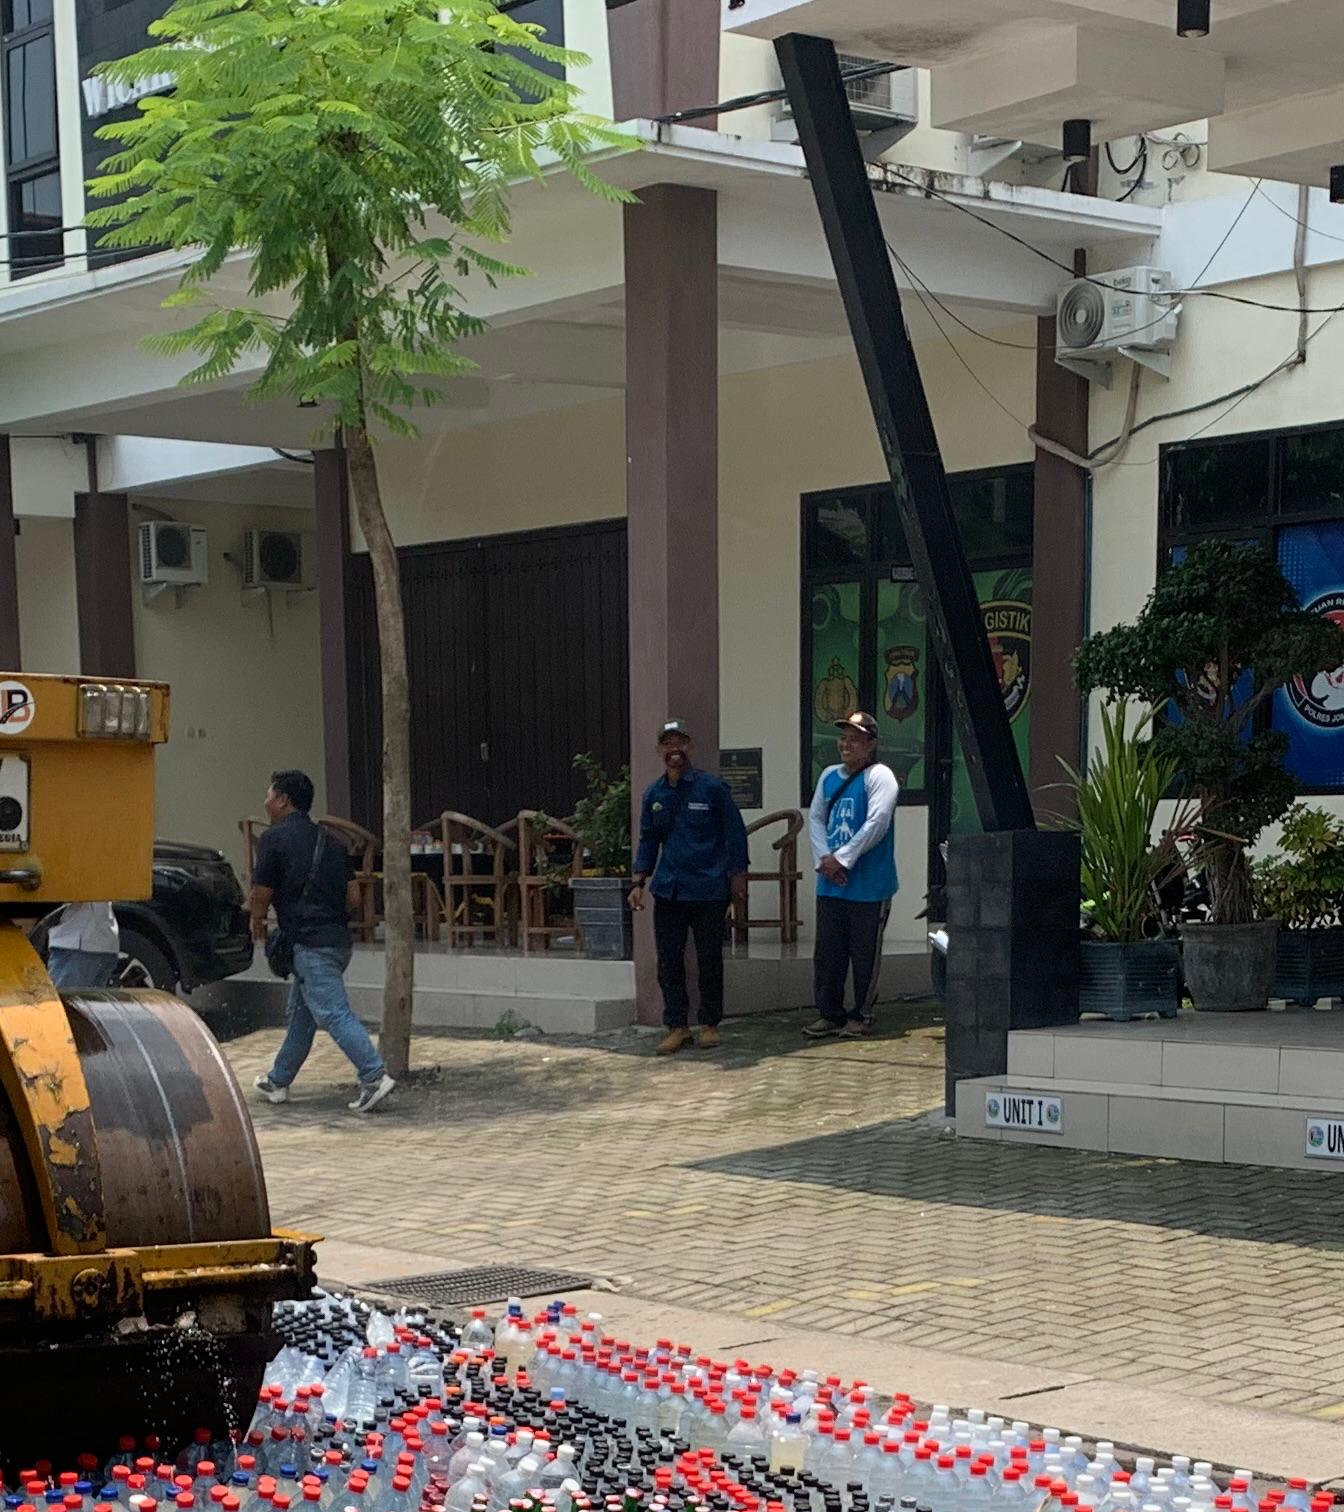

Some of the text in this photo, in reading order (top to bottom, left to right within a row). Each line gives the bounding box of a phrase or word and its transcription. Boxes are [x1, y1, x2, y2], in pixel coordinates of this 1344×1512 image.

[984, 610, 1031, 632] GISTIK
[1304, 703, 1330, 722] POLRES
[1003, 1097, 1043, 1126] UNIT I
